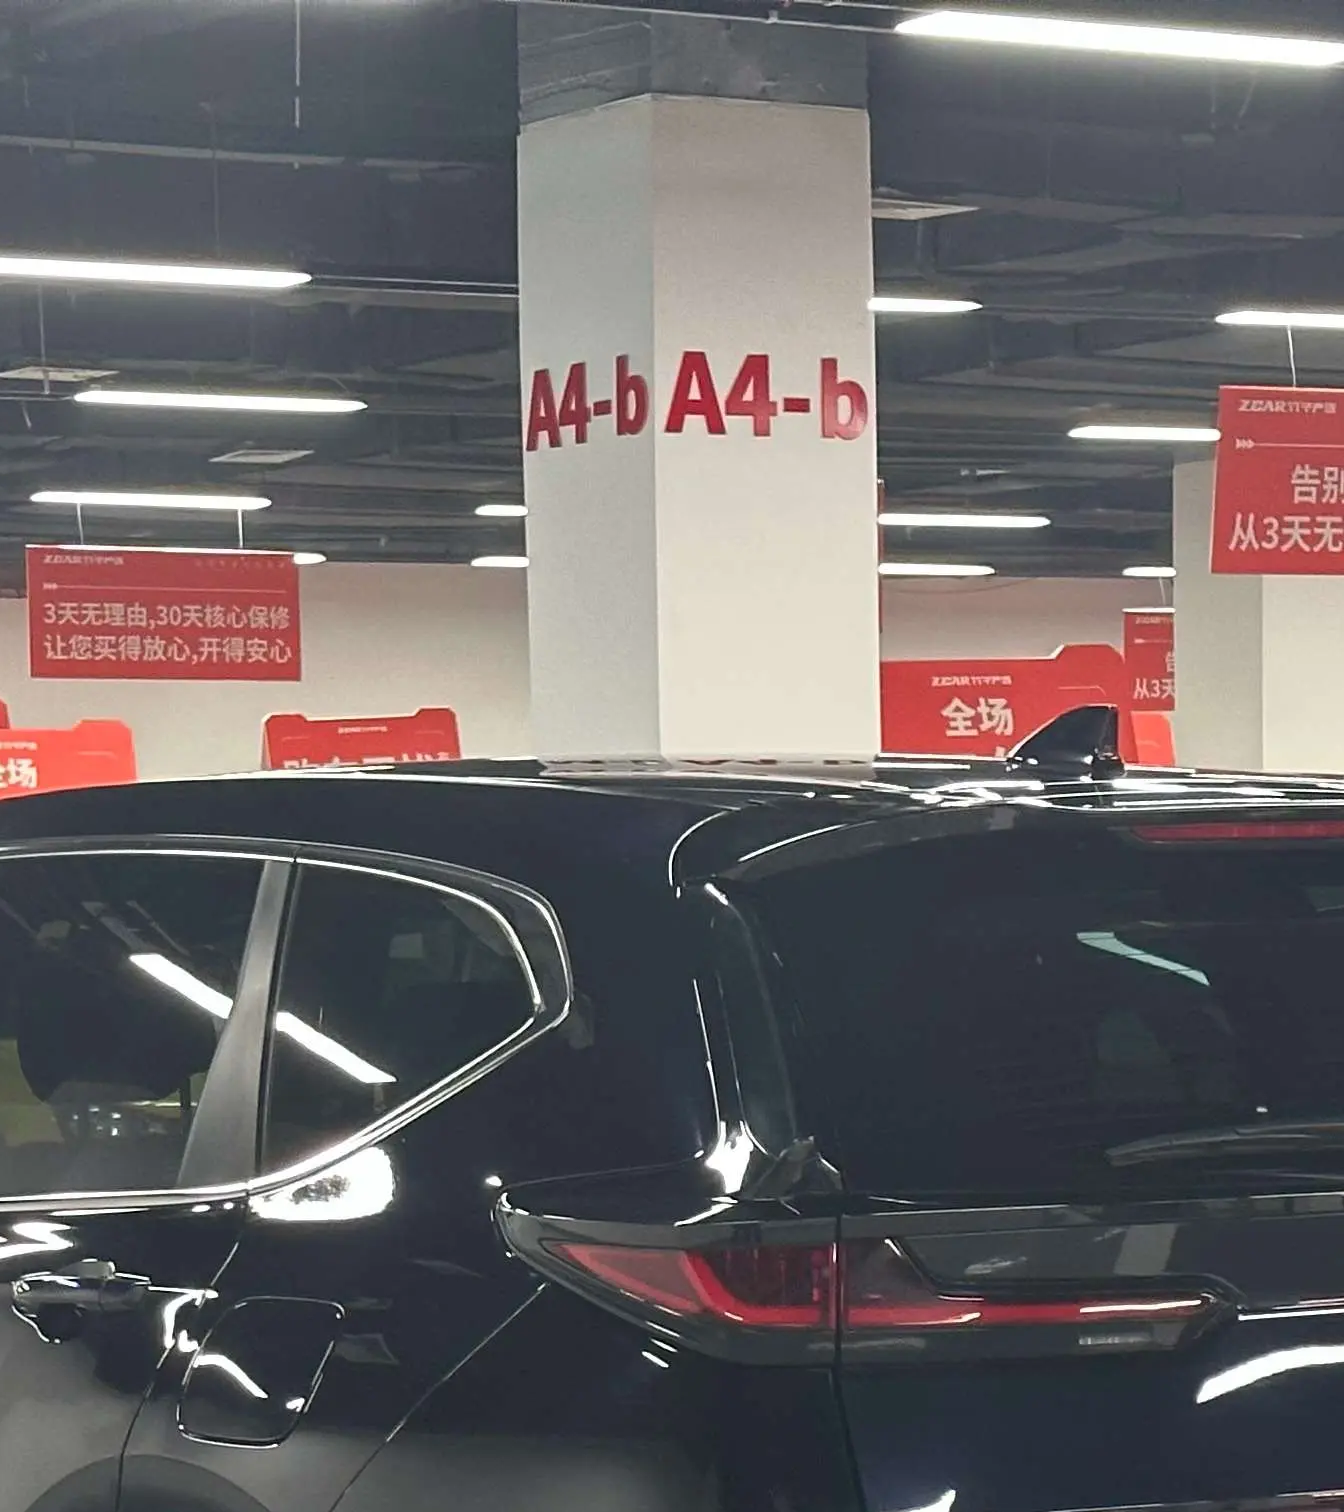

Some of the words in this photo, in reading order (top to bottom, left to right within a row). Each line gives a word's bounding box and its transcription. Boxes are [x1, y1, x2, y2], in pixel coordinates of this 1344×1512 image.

[525, 353, 649, 451] A4-b
[664, 350, 869, 441] A4-b
[43, 602, 290, 630] 3天无理由,30天核心保修
[43, 634, 292, 665] 让您买得放心,开得安心
[940, 697, 1014, 737] 全场
